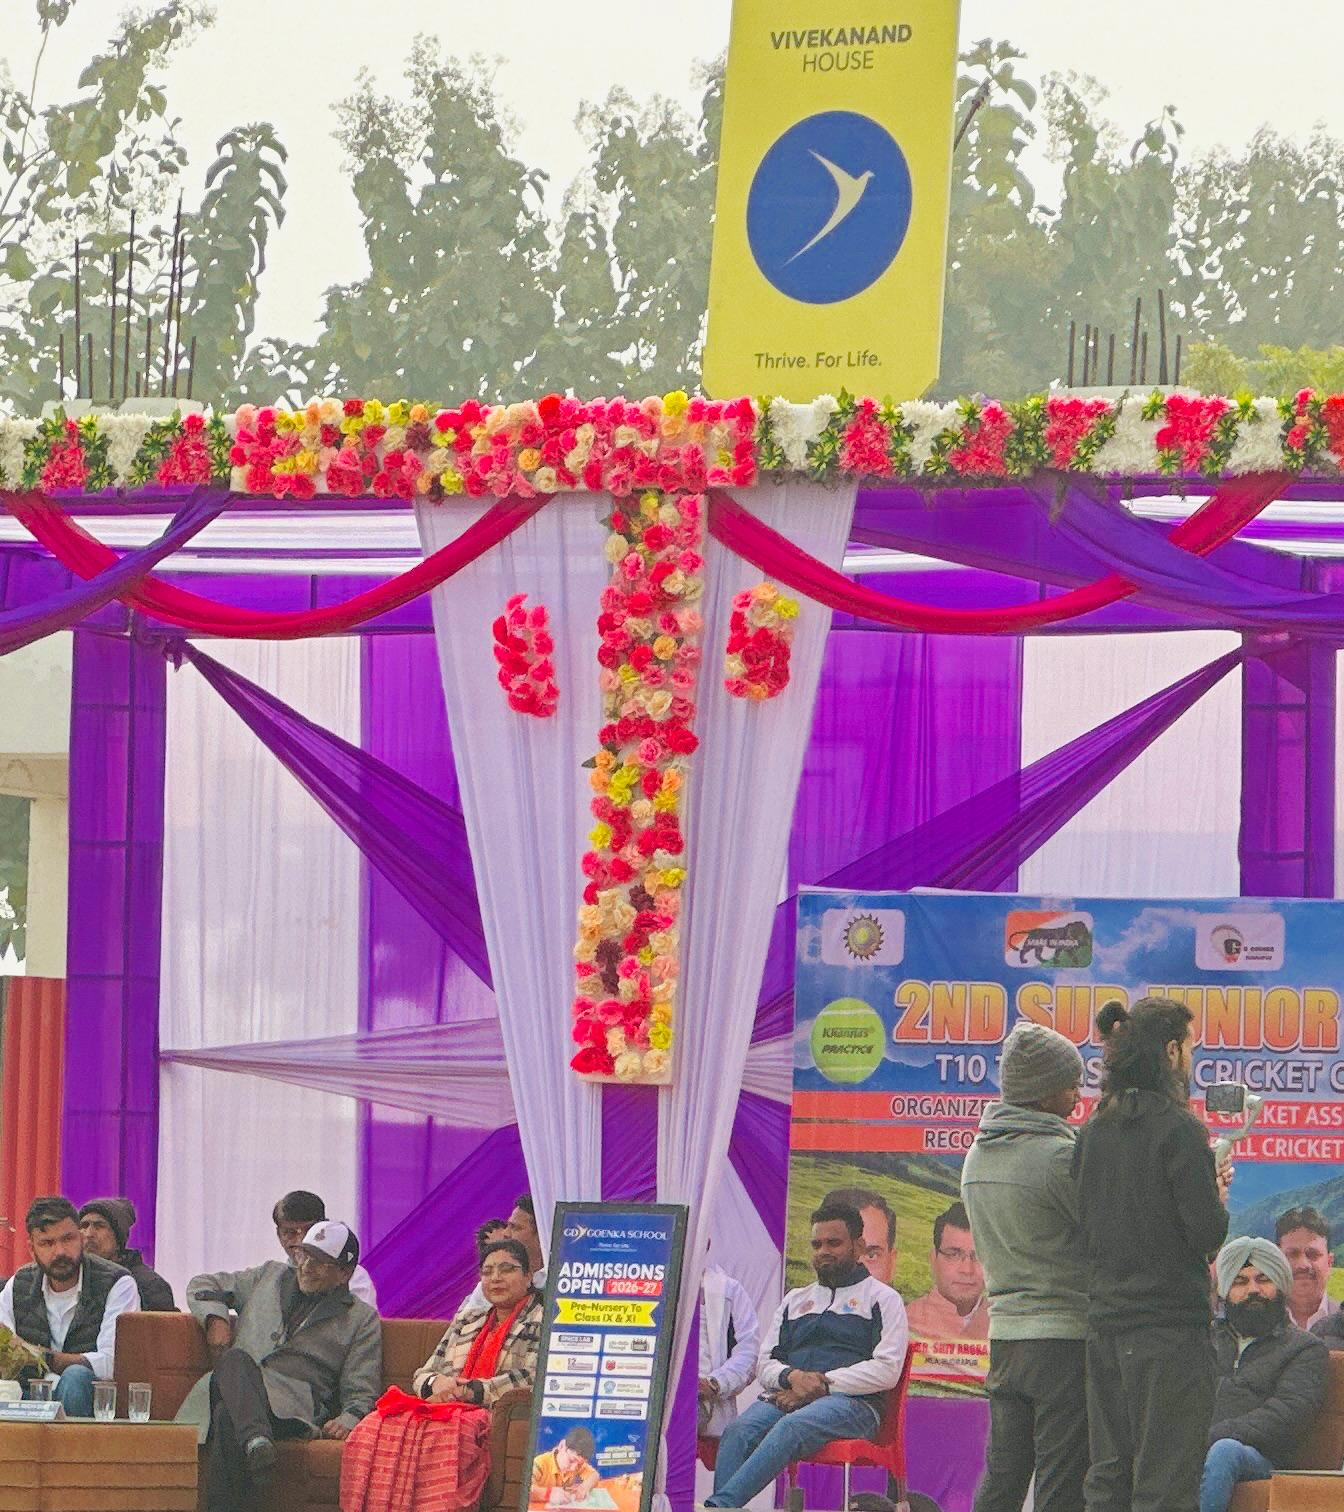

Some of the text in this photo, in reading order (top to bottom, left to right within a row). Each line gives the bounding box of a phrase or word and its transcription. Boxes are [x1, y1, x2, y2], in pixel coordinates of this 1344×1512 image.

[770, 24, 912, 50] VIVEKANAND
[802, 50, 874, 72] HOUSE
[755, 350, 882, 369] Thrive. For Life.
[894, 980, 1007, 1045] 2ND
[935, 1054, 987, 1083] T10
[1194, 1058, 1322, 1092] CRICKET
[1262, 1139, 1344, 1160] CRICKET
[587, 1229, 625, 1239] GOENKA
[627, 1231, 668, 1241] SCHOOL
[558, 1262, 665, 1281] ADMISSIONS
[557, 1279, 657, 1295] OPEN 2026-27
[570, 1302, 642, 1315] Pre-Nursery To
[574, 1313, 636, 1323] Class IX & XI
